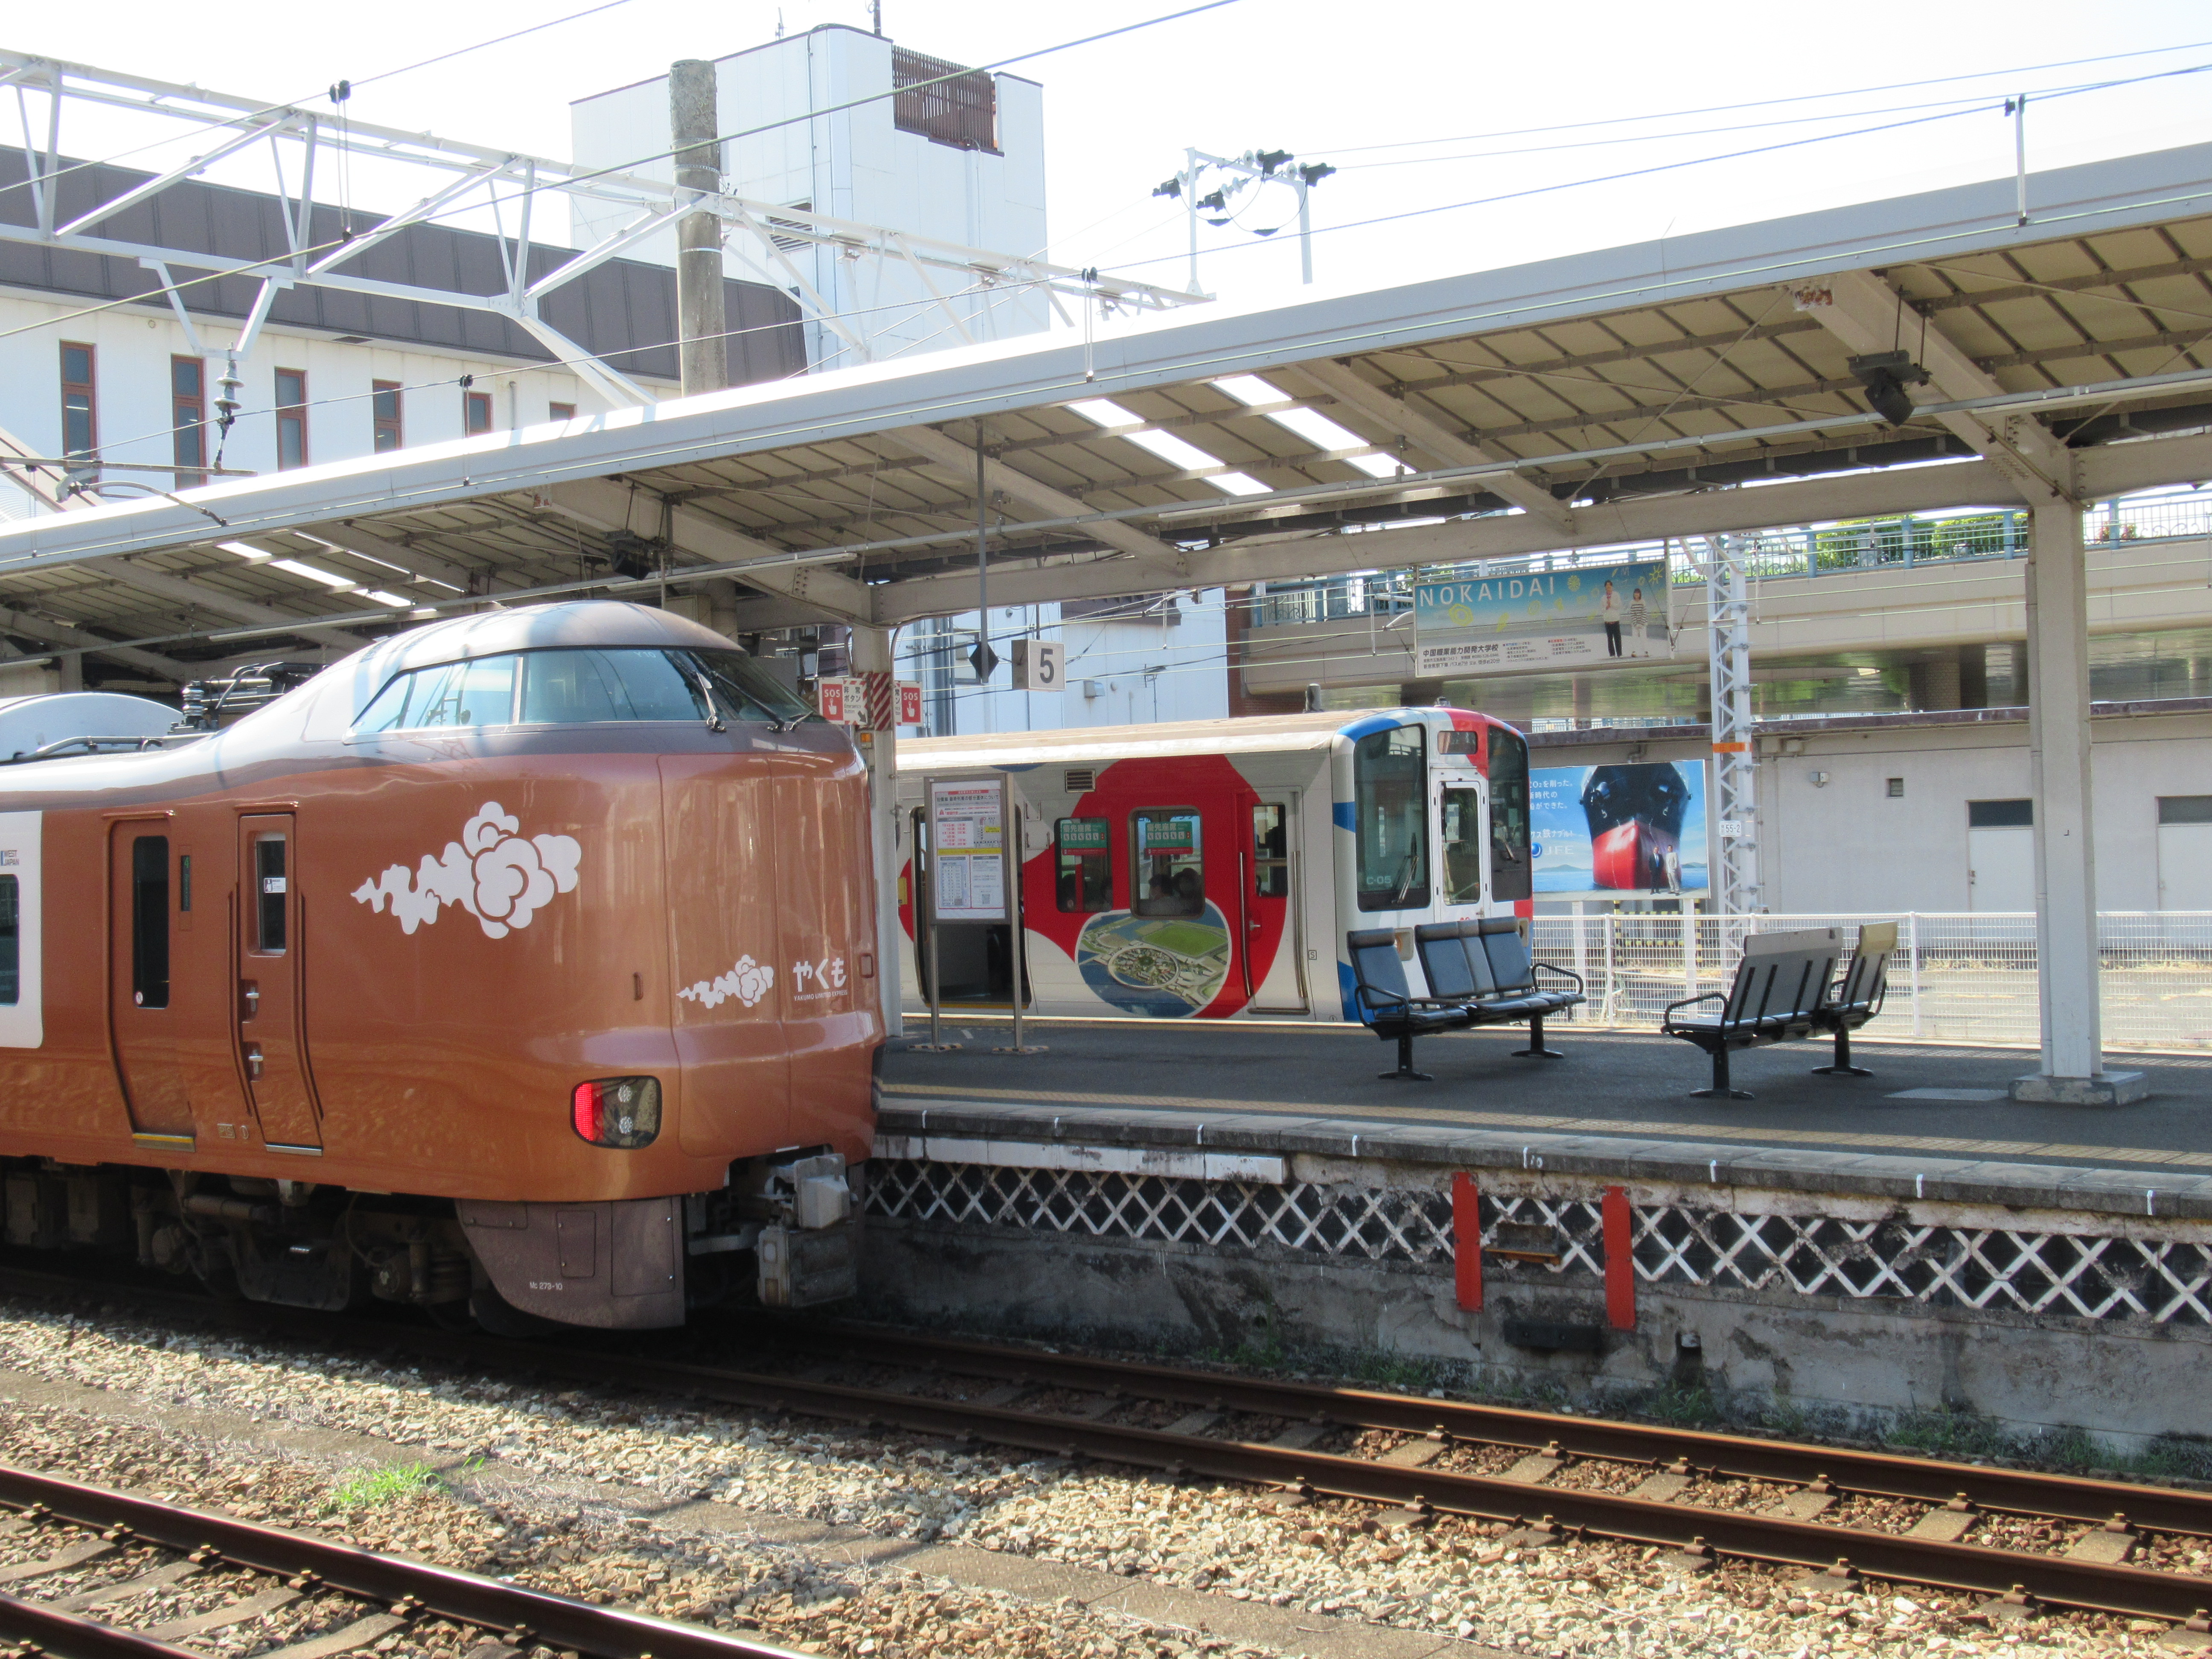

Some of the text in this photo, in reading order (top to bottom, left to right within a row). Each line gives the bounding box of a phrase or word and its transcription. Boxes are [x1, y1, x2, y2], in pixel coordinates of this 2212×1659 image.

[1420, 576, 1554, 607] NOKAIDAI
[1423, 644, 1499, 657] 中国職業能力開発大学校
[1039, 648, 1054, 684] 5
[824, 690, 841, 698] SOS
[903, 693, 918, 701] SOS
[844, 695, 861, 703] ボタン
[1725, 824, 1740, 832] 55-2
[1544, 846, 1574, 855] JFE
[793, 958, 847, 992] やくも
[539, 1282, 562, 1290] 273-10
